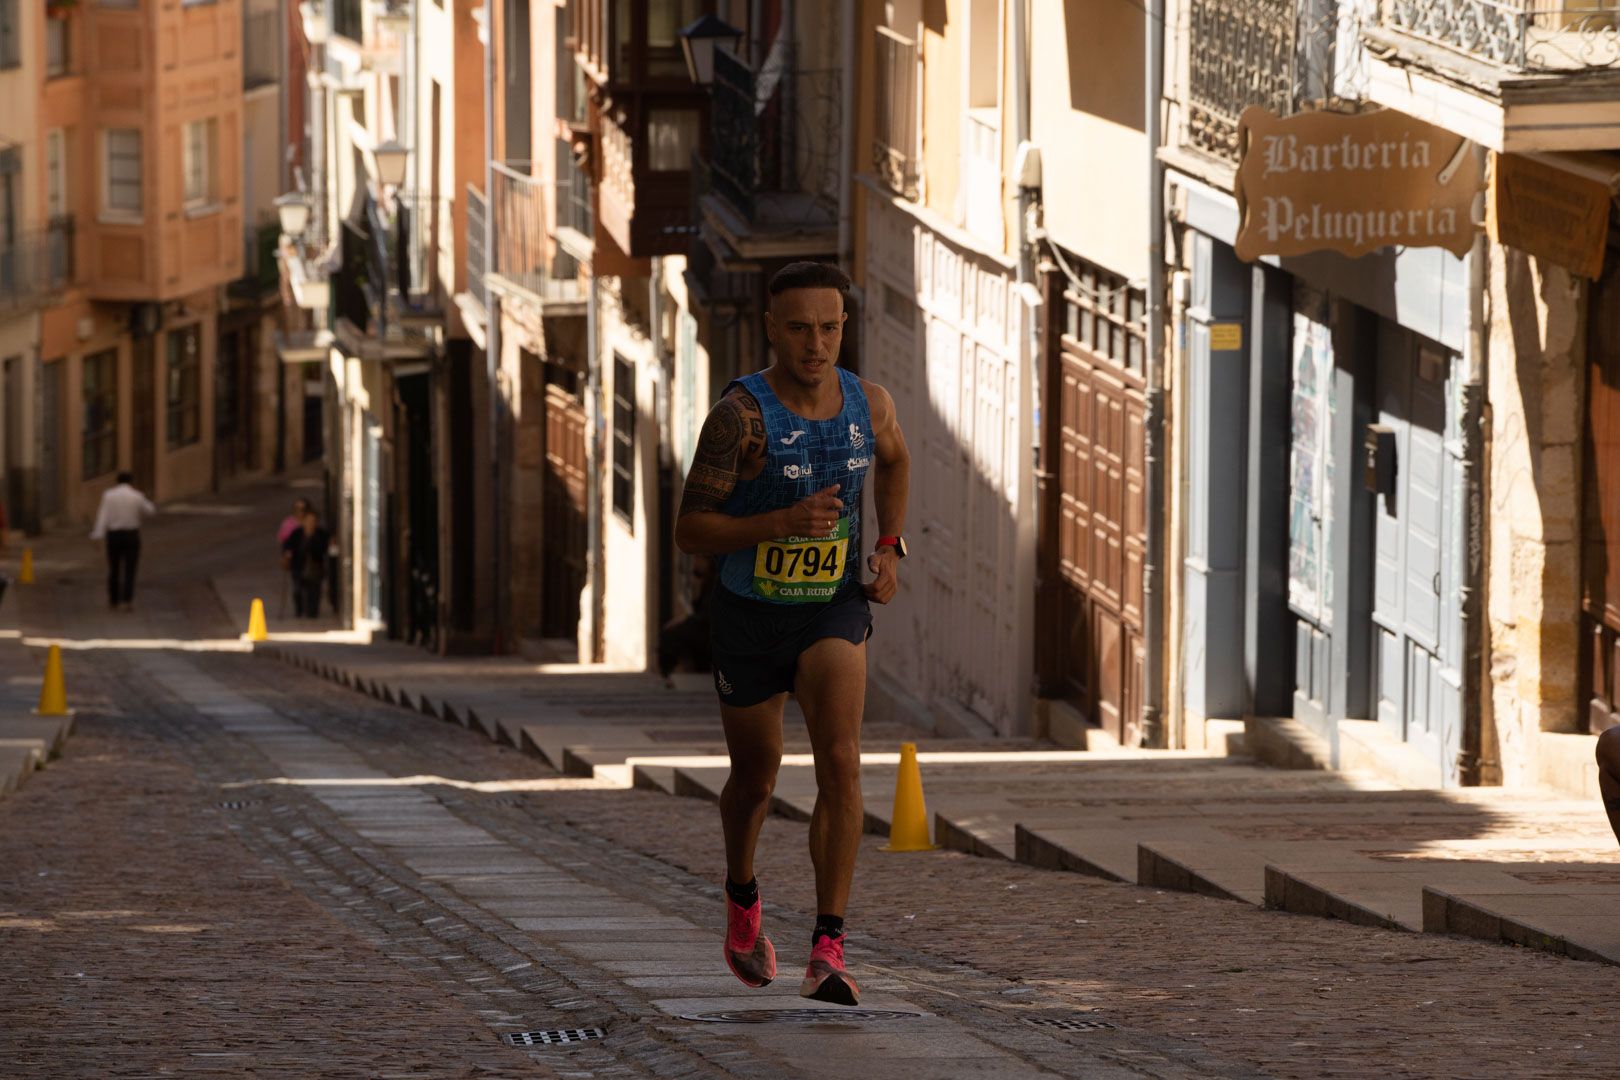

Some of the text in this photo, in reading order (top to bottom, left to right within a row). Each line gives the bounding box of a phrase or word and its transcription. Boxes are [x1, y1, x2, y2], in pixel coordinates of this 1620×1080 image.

[1262, 131, 1431, 179] Barbería
[1260, 196, 1457, 245] Peluquería
[765, 545, 838, 578] 0794
[779, 586, 837, 596] CAJA RURAL
